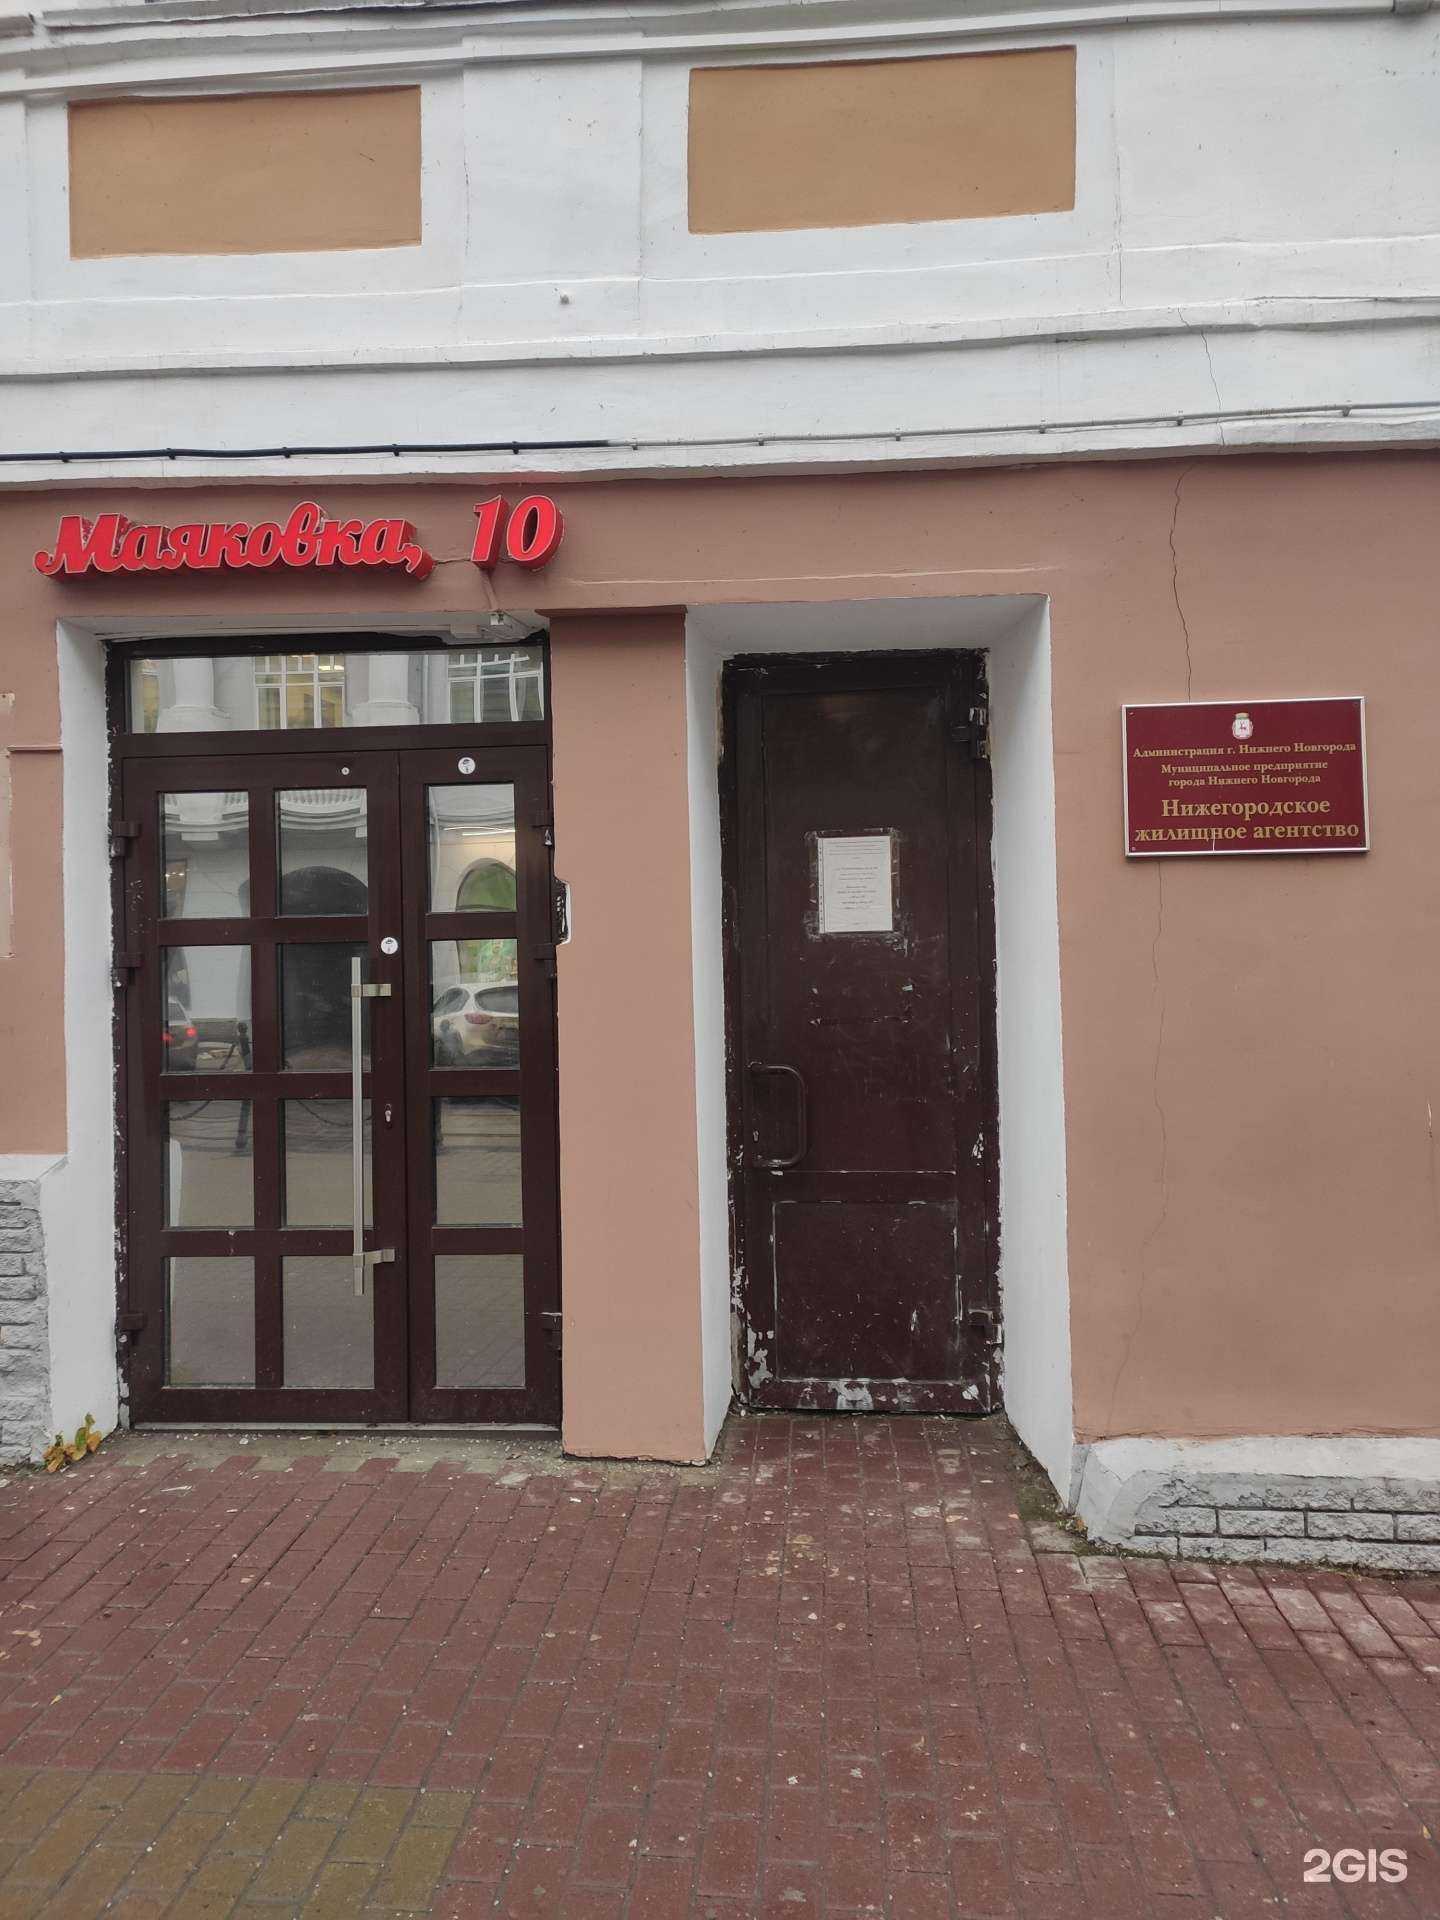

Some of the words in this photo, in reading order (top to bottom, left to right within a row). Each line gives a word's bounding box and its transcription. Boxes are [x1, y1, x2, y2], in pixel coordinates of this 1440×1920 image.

[33, 501, 434, 580] Маяковка,
[471, 495, 565, 569] 10
[1133, 747, 1224, 758] Администрация
[1227, 747, 1236, 755] г.
[1239, 744, 1291, 754] Нижнего
[1294, 742, 1356, 753] Новгорода
[1161, 763, 1251, 774] Муниципальное
[1254, 761, 1328, 772] предприятие
[1168, 778, 1205, 788] города
[1208, 775, 1258, 785] Нижнего
[1261, 774, 1321, 785] Новгорода
[1161, 799, 1331, 820] Нижегородское
[1135, 826, 1248, 842] жилищное
[1253, 824, 1359, 839] агентство
